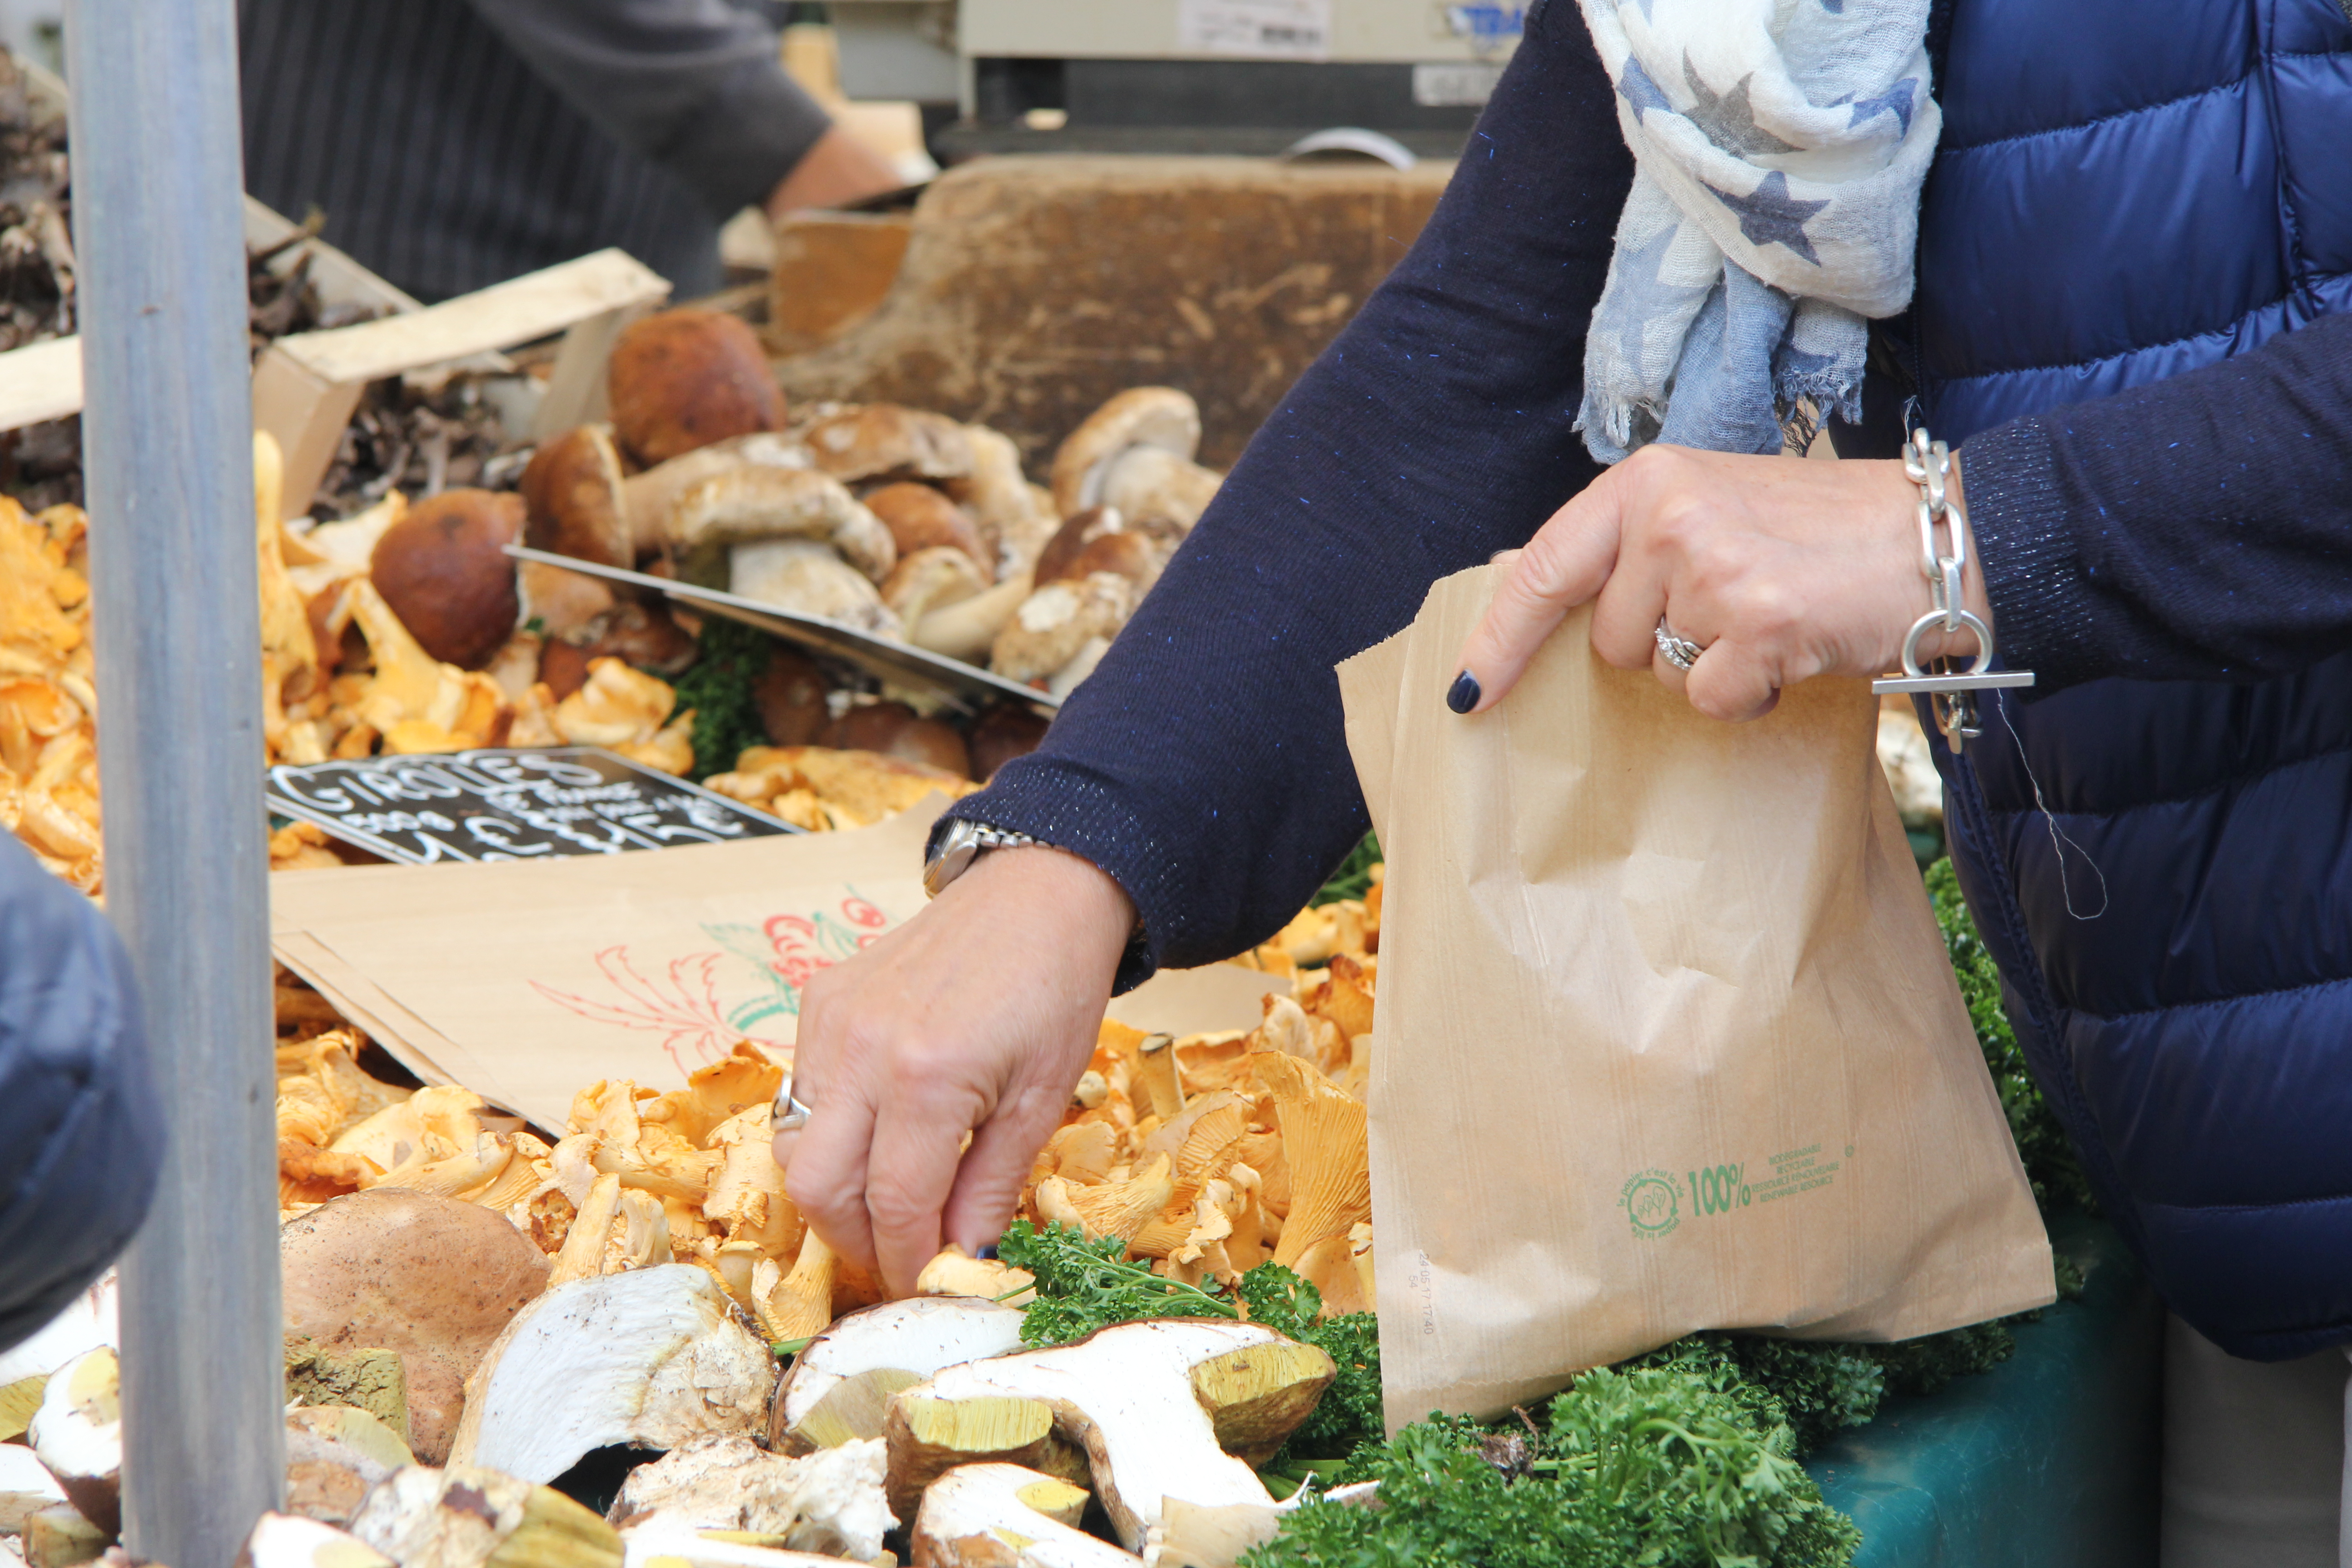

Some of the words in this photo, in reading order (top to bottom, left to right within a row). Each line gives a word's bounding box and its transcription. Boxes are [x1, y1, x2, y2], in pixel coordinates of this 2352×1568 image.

[271, 754, 604, 812] GIROLLES
[1776, 1156, 1815, 1174] RECYCLABLE
[1621, 1171, 1643, 1196] papier
[1688, 1161, 1751, 1216] 100%
[1752, 1175, 1789, 1192] RESSOURCE
[1800, 1174, 1833, 1191] RESOURCE
[1658, 1217, 1680, 1238] paper
